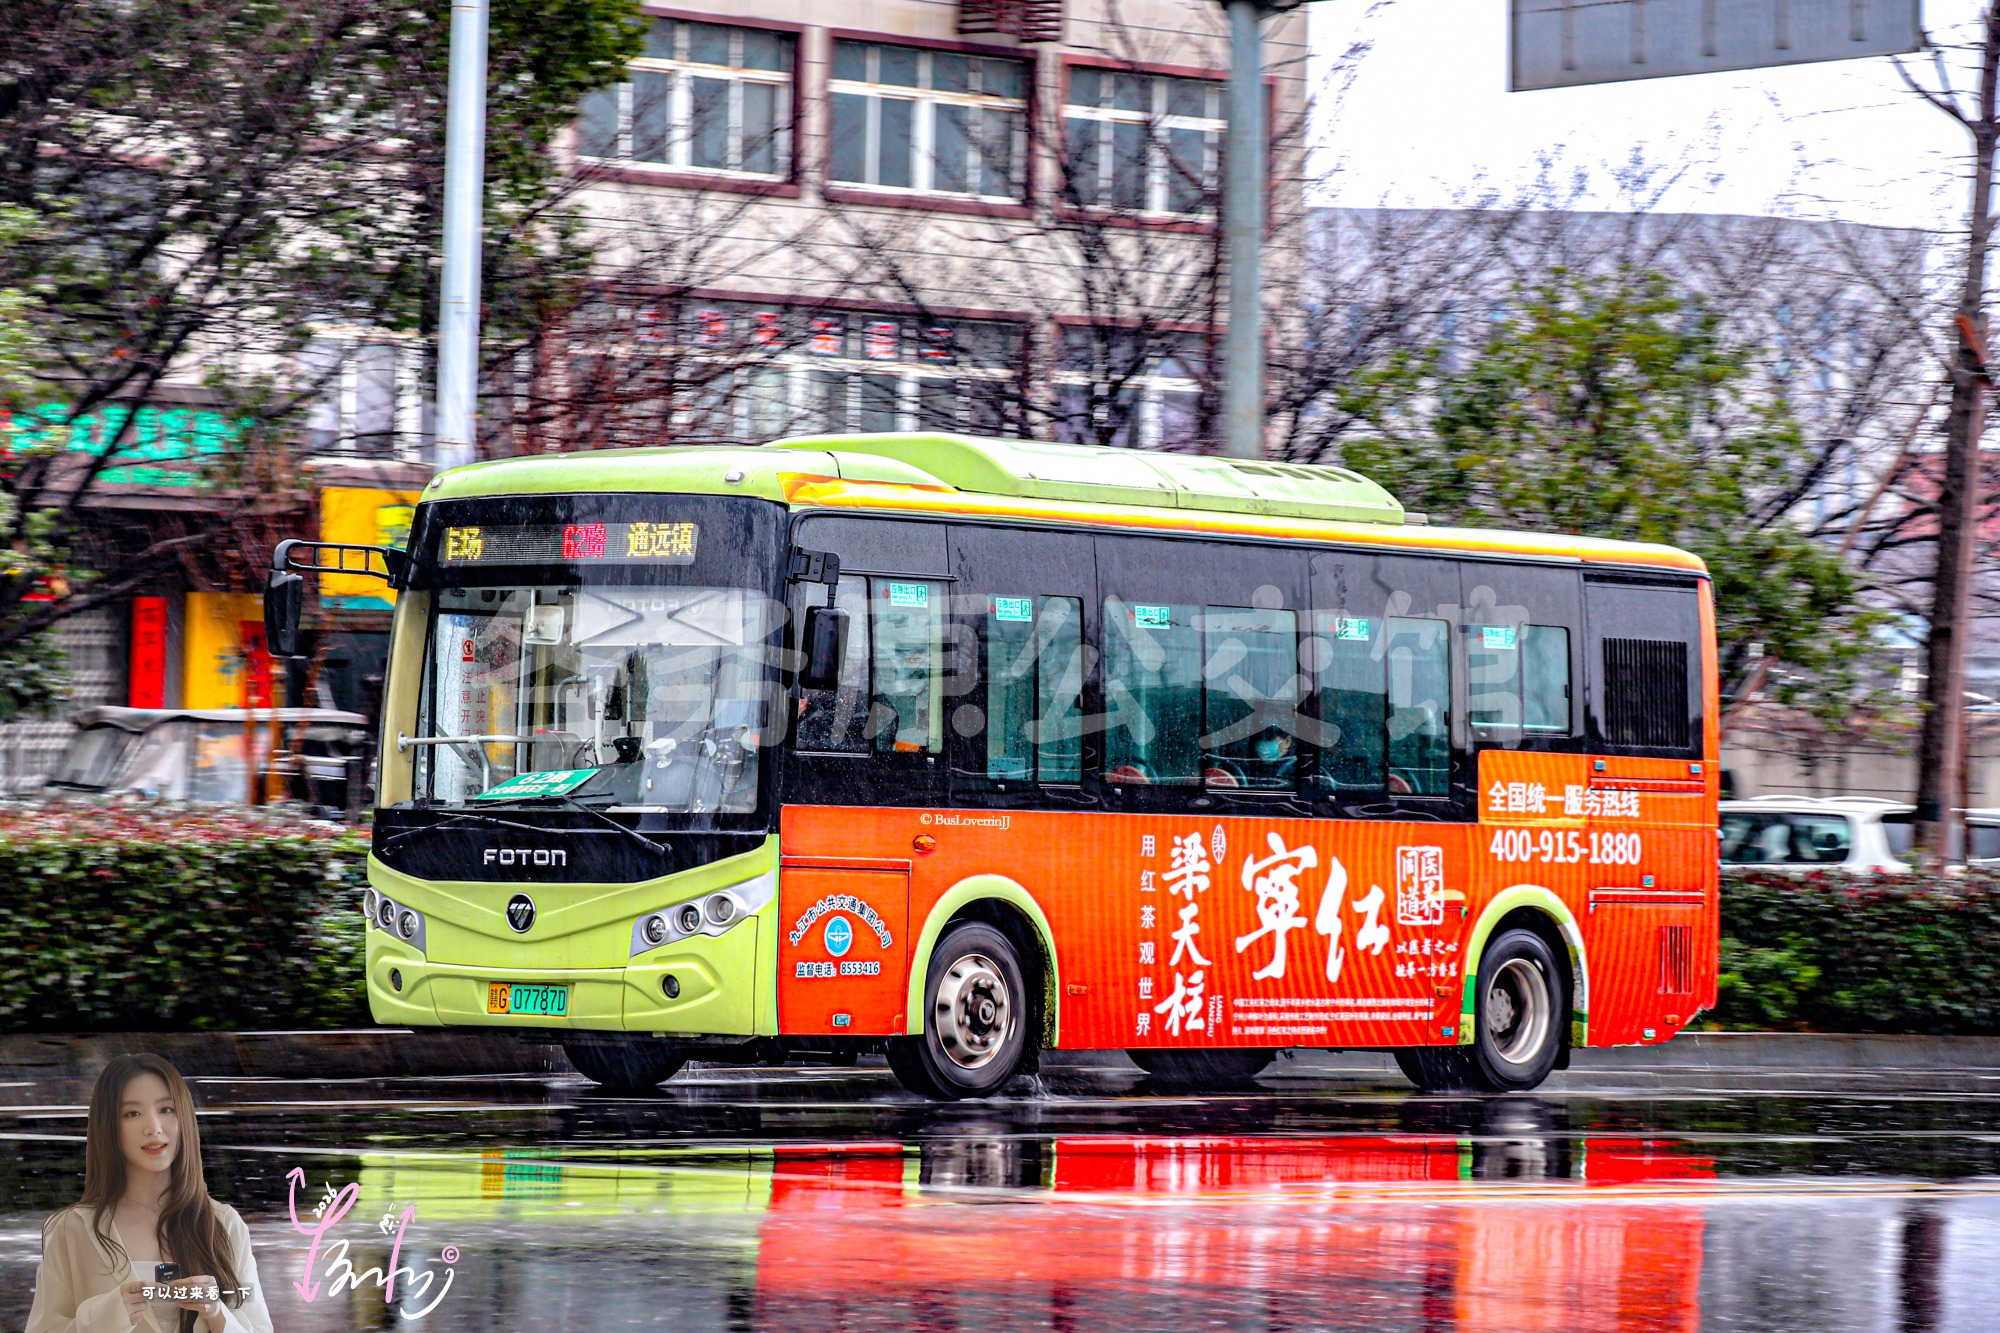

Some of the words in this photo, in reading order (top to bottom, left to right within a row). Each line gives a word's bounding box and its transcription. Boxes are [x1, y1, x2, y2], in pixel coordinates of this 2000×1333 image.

[561, 522, 607, 560] 62路
[626, 521, 696, 558] 通远镇
[1487, 781, 1641, 818] 全国统一服务热线
[483, 848, 567, 867] FOTON
[1489, 829, 1642, 865] 400-915-1880
[789, 894, 893, 949] 九江市公共交通集团公司
[1135, 835, 1156, 1037] 用红茶观世界
[1154, 831, 1212, 1037] 梁天柱
[1207, 995, 1216, 1038] TIANZHU
[1215, 995, 1224, 1024] LIANG
